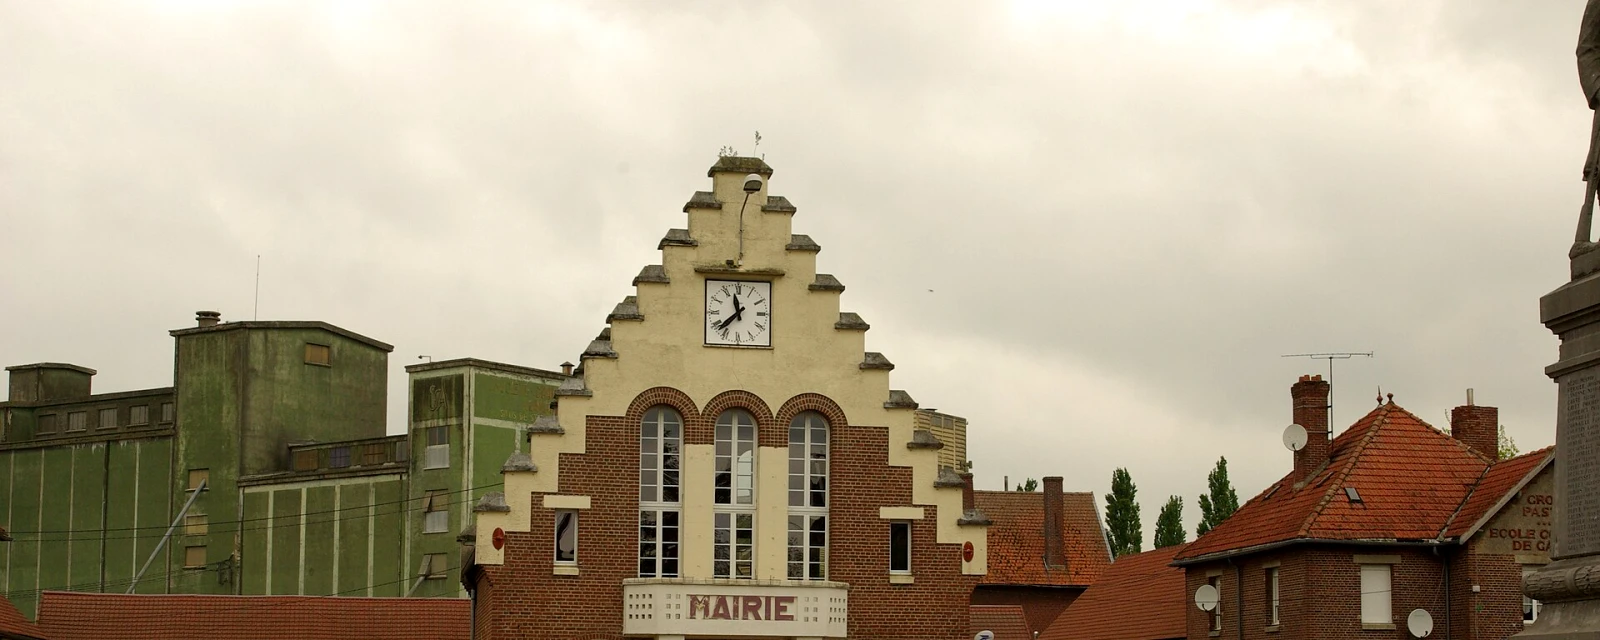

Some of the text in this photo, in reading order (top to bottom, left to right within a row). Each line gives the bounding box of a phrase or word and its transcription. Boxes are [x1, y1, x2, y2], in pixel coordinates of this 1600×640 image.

[1522, 507, 1552, 517] PAS
[1489, 528, 1535, 539] ECOLE
[1512, 540, 1532, 551] DE
[689, 595, 795, 620] MAIRIE
